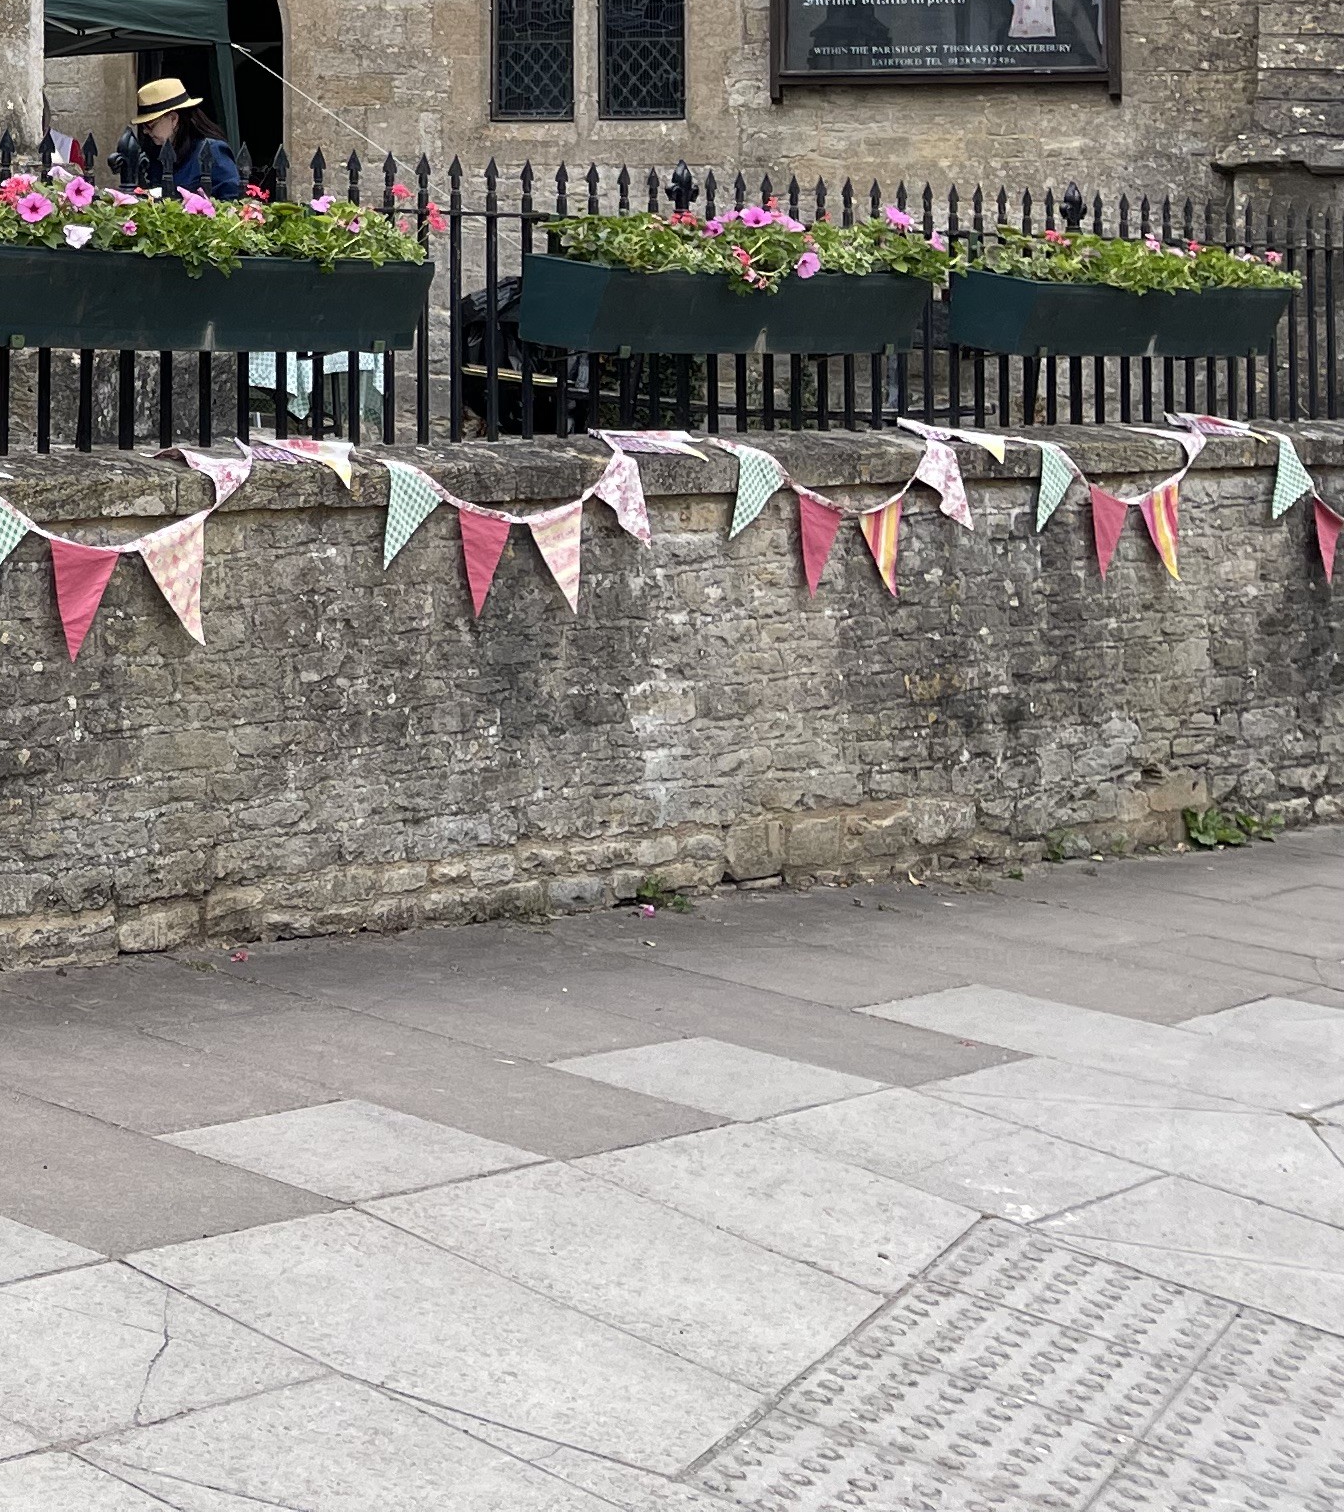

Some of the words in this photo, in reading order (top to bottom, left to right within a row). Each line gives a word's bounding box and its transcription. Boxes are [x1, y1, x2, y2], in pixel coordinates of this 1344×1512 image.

[813, 46, 849, 55] WITHIN
[850, 46, 869, 55] THE
[871, 45, 909, 55] PARISH
[909, 45, 923, 54] OF
[925, 44, 938, 54] ST
[942, 44, 990, 54] THOMAS
[990, 44, 1005, 53] OF
[1006, 43, 1072, 53] CANTERBURY
